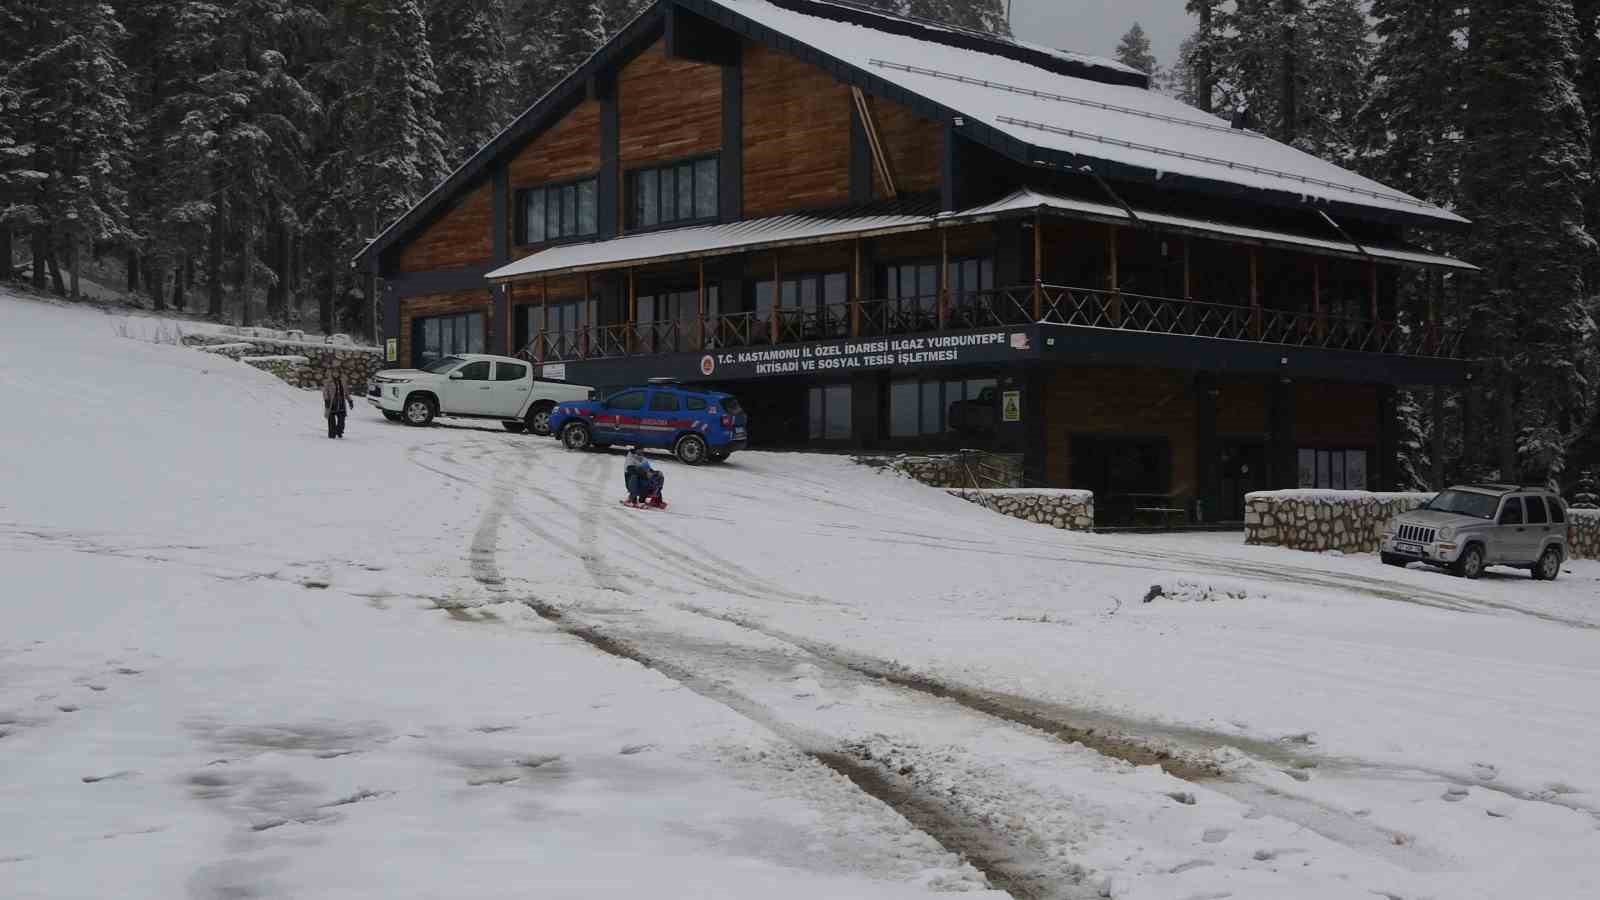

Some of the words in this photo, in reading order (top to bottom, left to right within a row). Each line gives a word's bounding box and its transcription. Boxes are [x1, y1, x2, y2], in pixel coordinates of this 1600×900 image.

[718, 354, 736, 364] T.C.
[738, 348, 800, 363] KASTAMONU
[803, 345, 813, 358] İL
[815, 343, 842, 356] ÖZEL
[845, 340, 888, 353] İDARESİ
[891, 338, 925, 351] ILGAZ
[927, 333, 1005, 347] YURDUNTEPE
[802, 360, 815, 370] VE
[818, 357, 860, 368] SOSYAL
[864, 353, 894, 366] TESİS
[898, 347, 958, 365] İŞLETMESİ
